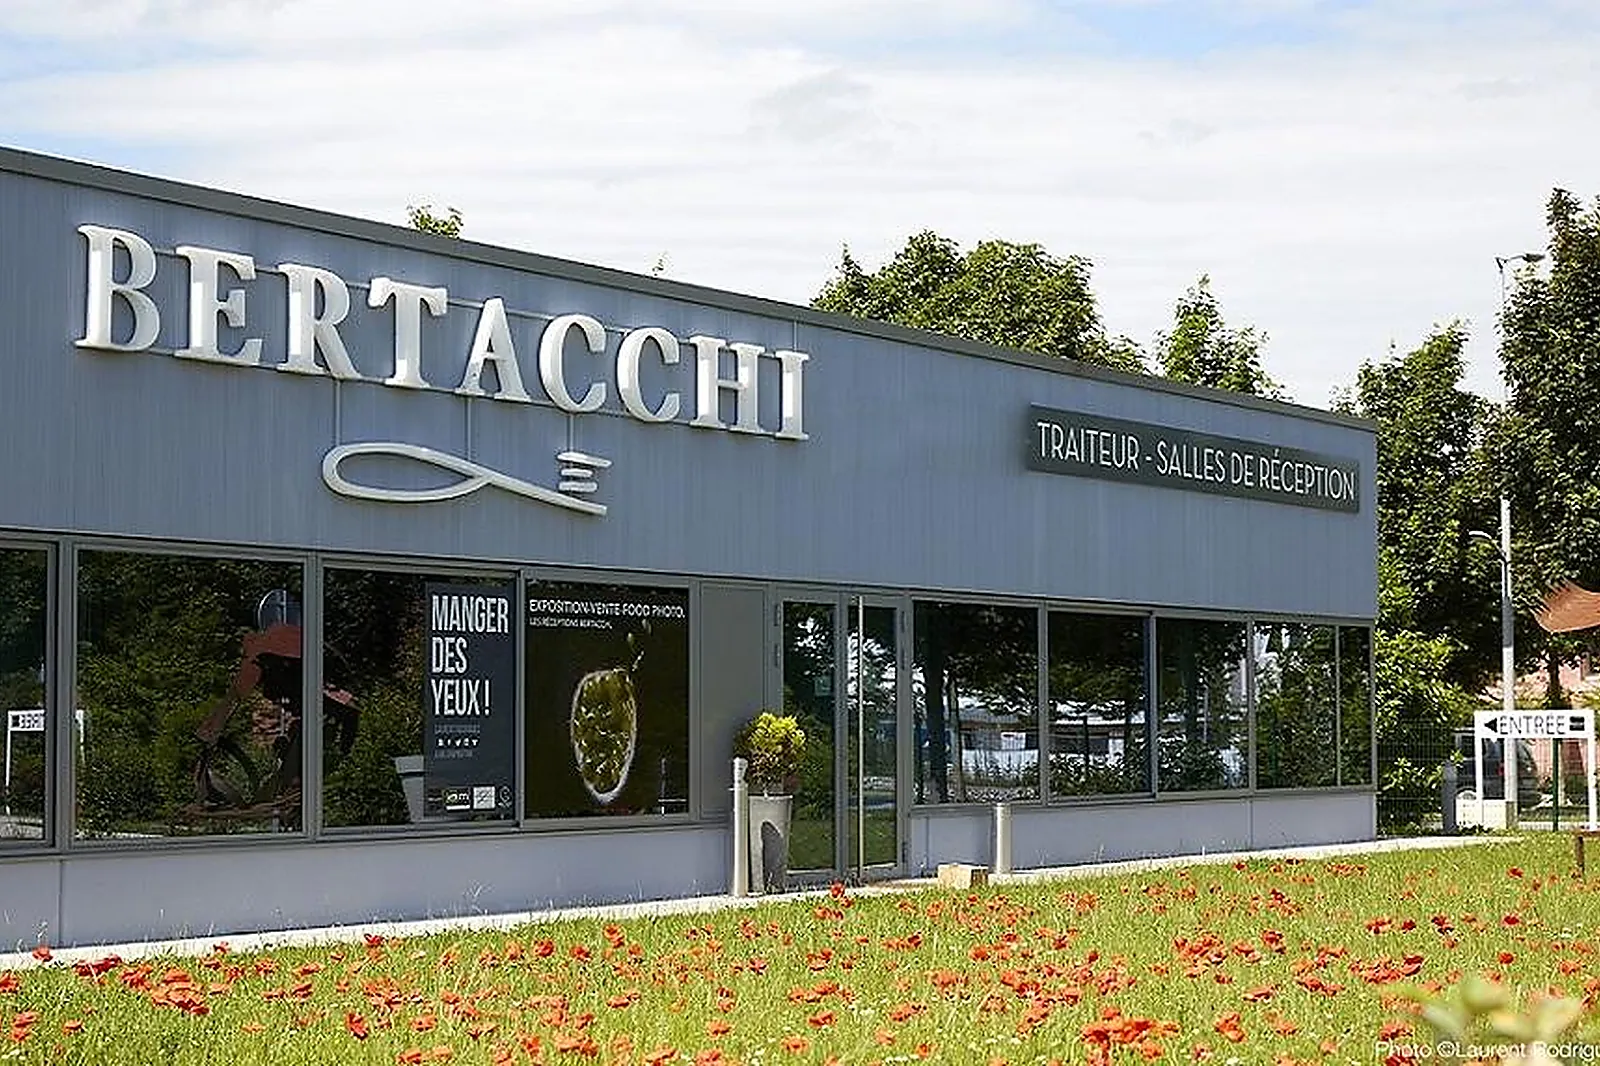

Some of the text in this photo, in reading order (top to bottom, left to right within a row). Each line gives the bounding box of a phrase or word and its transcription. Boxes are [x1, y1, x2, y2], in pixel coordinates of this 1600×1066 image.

[74, 224, 810, 441] BERTACCHI
[1037, 421, 1139, 470] TRAITEUR
[1156, 440, 1226, 483] SALLES
[1231, 452, 1255, 487] DE
[1260, 448, 1355, 500] RÉCEPTION
[432, 595, 509, 634] MANGER
[432, 637, 467, 673] DES
[431, 679, 480, 715] YEUX
